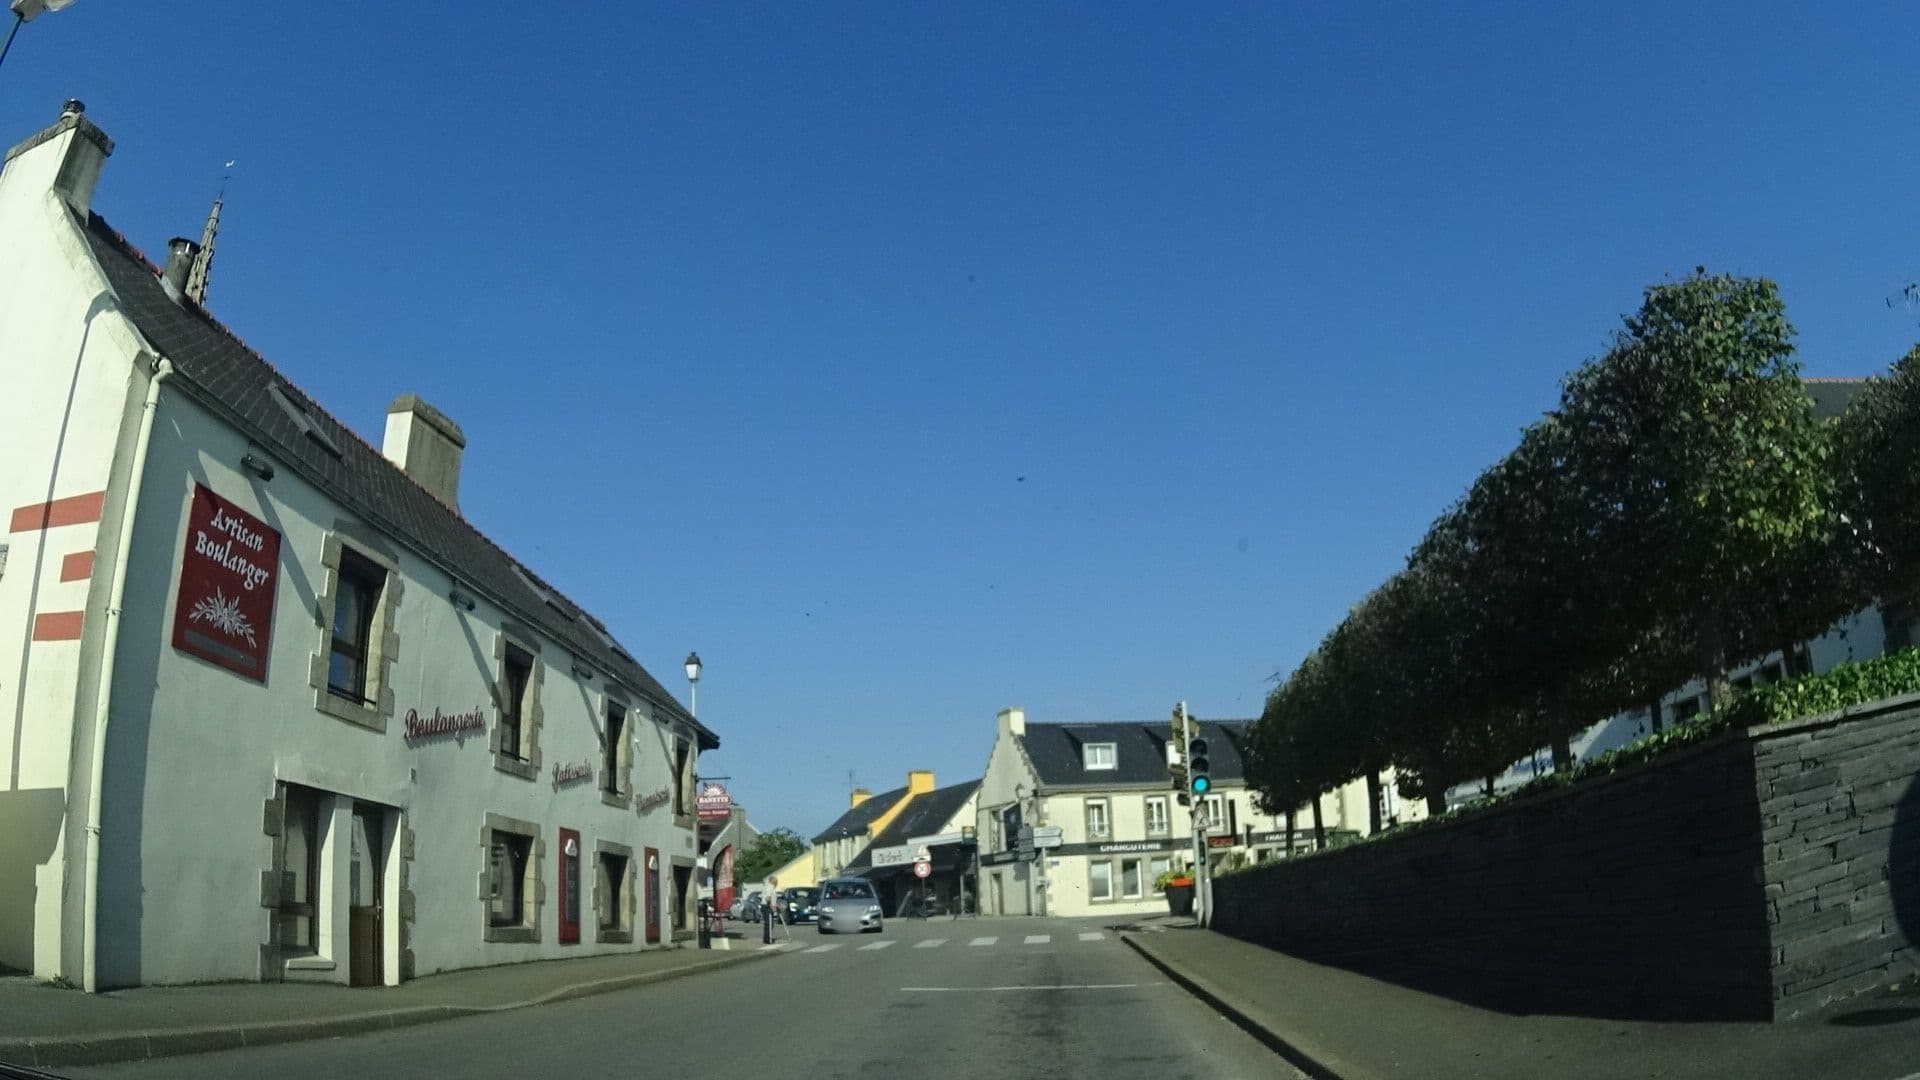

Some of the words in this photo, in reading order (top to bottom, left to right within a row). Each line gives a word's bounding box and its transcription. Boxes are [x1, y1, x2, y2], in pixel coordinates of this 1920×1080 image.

[210, 507, 264, 552] Artisan
[195, 530, 269, 590] Boulanger
[404, 706, 486, 741] Boulangerie
[1100, 842, 1161, 853] CHARCUTERIE
